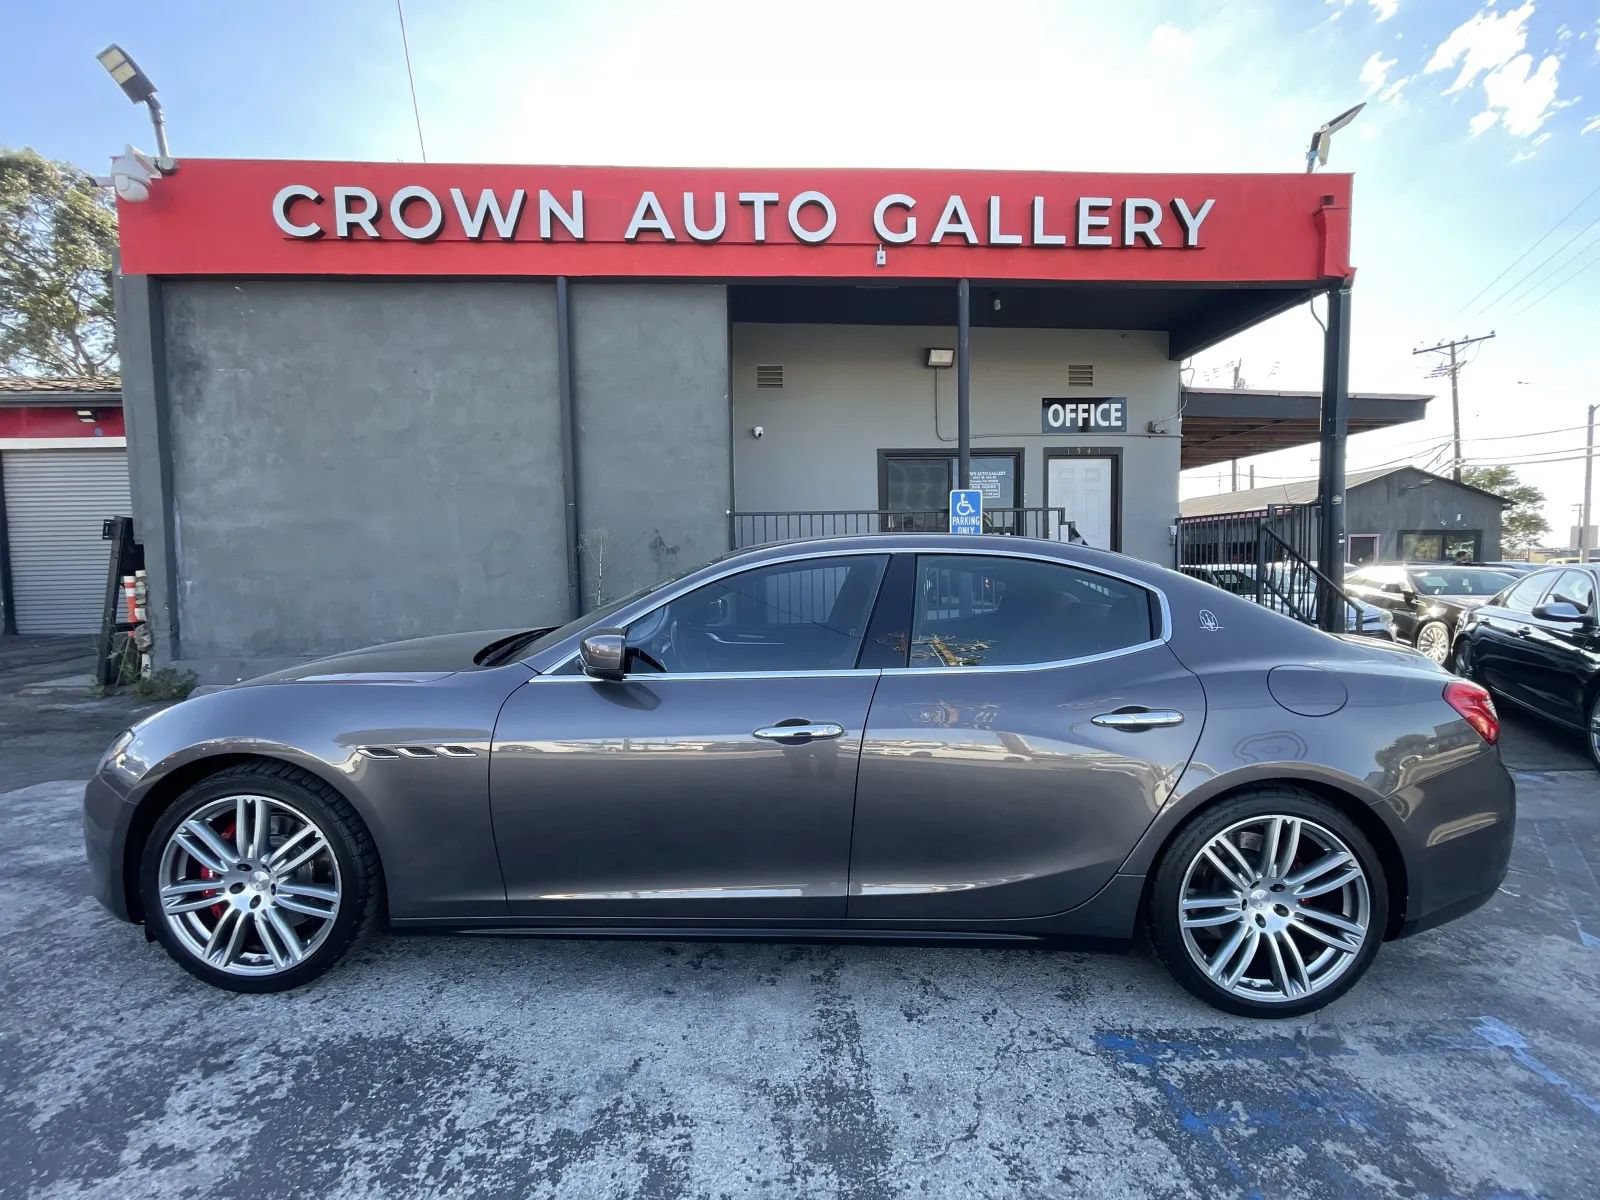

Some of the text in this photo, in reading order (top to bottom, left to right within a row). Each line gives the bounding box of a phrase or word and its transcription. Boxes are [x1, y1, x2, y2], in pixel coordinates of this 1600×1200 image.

[272, 184, 1216, 247] CROWN AUTO GALLERY
[1048, 403, 1122, 428] OFFICE
[952, 516, 980, 526] PARKING
[957, 526, 976, 535] ONLY
